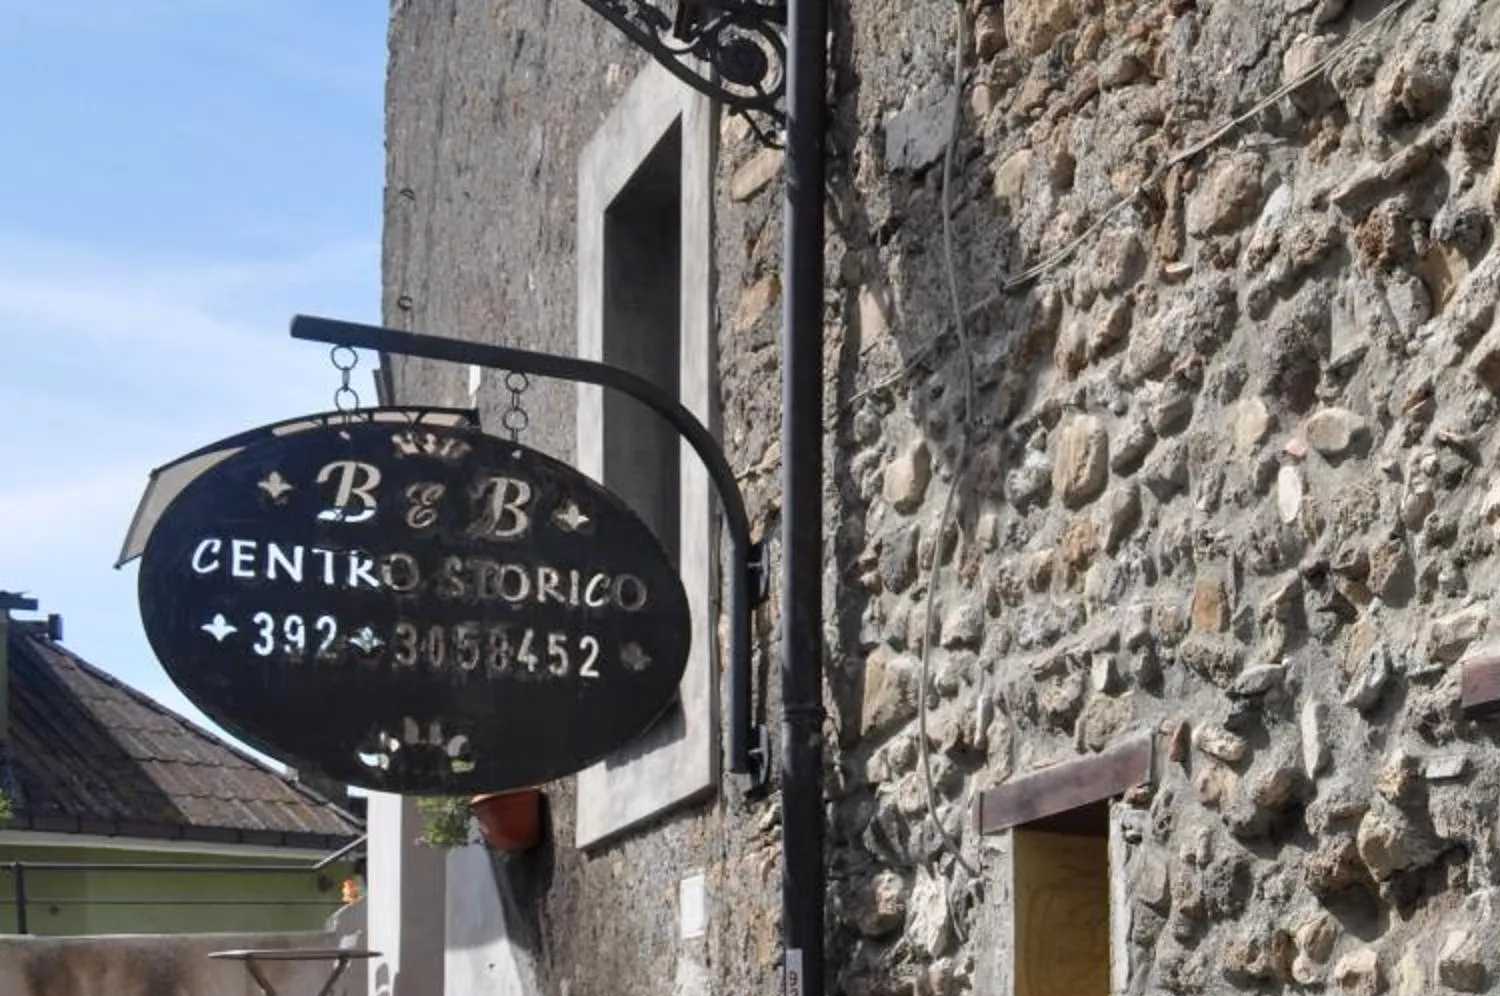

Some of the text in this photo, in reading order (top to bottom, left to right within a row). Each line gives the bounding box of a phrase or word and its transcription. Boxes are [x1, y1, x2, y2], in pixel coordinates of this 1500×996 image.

[315, 460, 533, 539] B & B
[191, 538, 648, 612] CENTRO STORICO
[252, 611, 600, 678] 392 3058452
